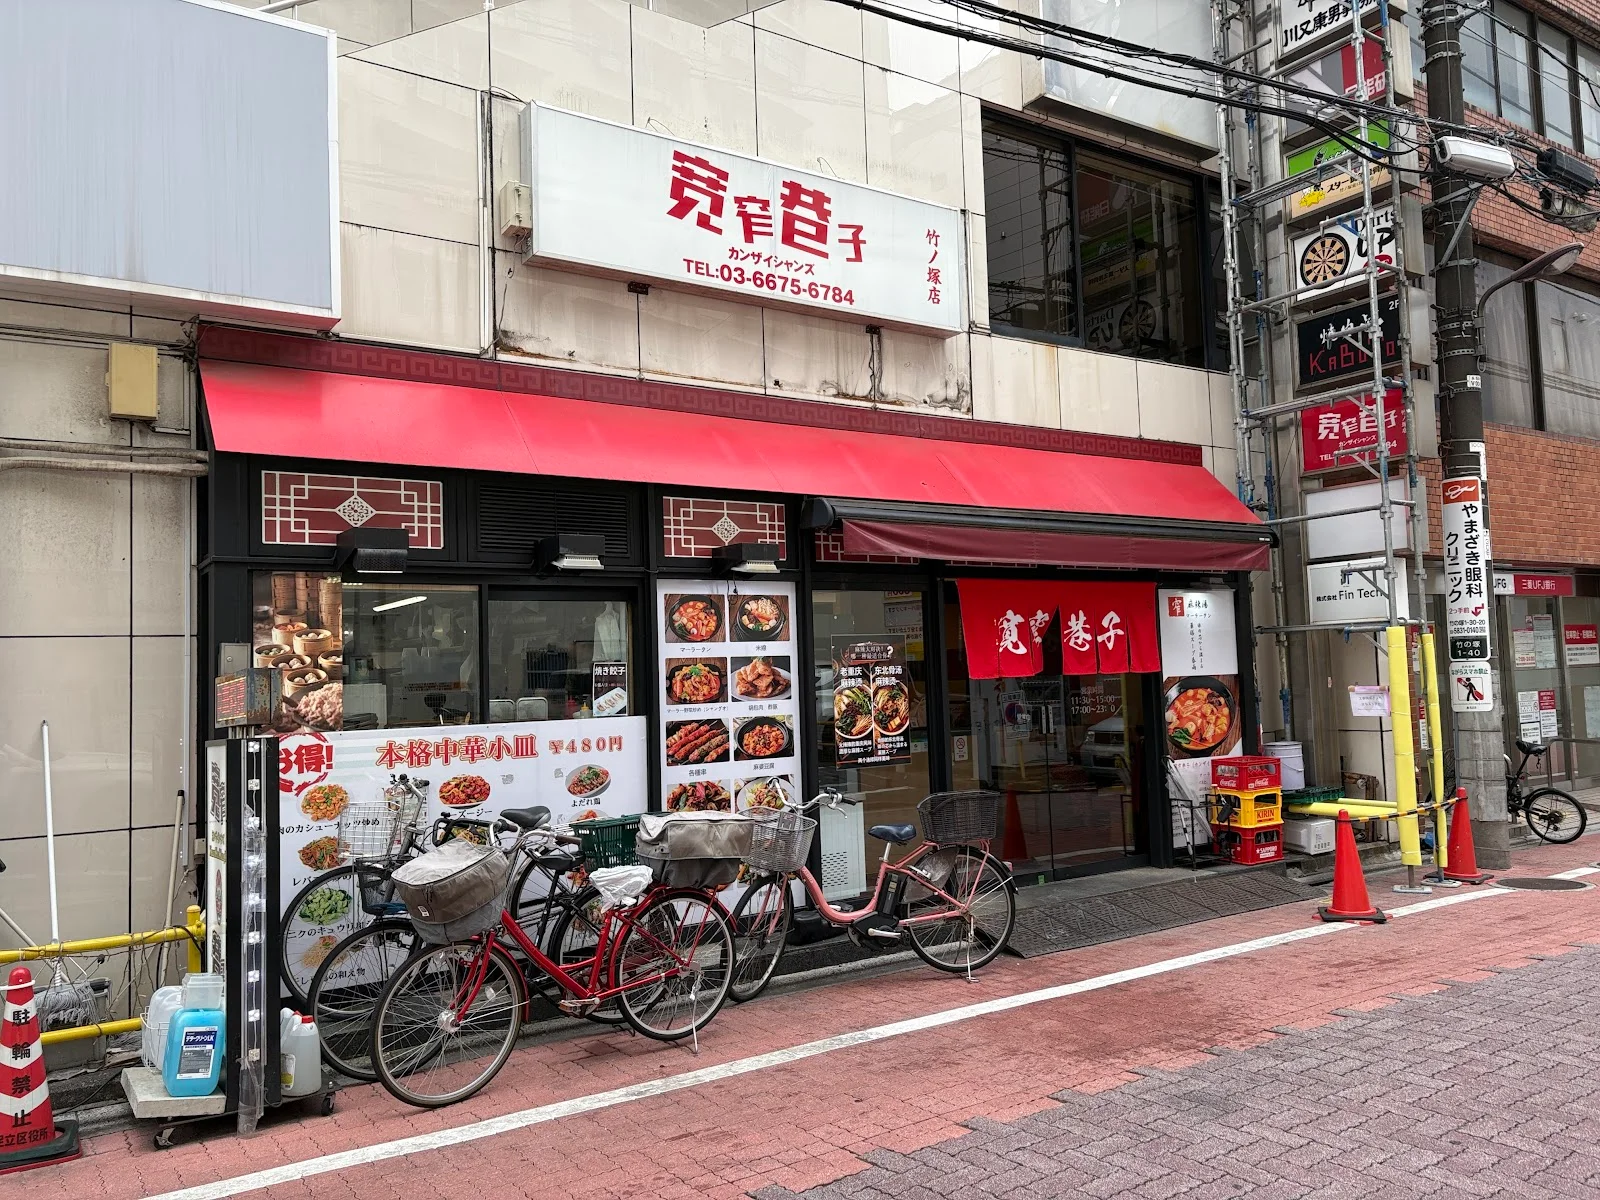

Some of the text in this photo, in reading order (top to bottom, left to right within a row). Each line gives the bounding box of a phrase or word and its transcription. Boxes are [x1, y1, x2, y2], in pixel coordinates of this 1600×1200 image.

[1354, 209, 1395, 232] Drts
[728, 246, 815, 276] カンザイシャンズ
[926, 228, 942, 305] 竹ノ塚店
[1462, 503, 1483, 598] やまざき眼科
[1446, 532, 1462, 603] クリニック
[1339, 590, 1354, 600] Fin
[1357, 588, 1382, 599] Tech
[1456, 641, 1481, 649] 竹の塚
[595, 666, 626, 676] 焼き餃子
[376, 734, 539, 769] 本格中華小皿
[571, 798, 601, 808] よだれ鶏
[1256, 809, 1275, 819] KIRIN
[12, 1008, 32, 1128] 駐輪禁止
